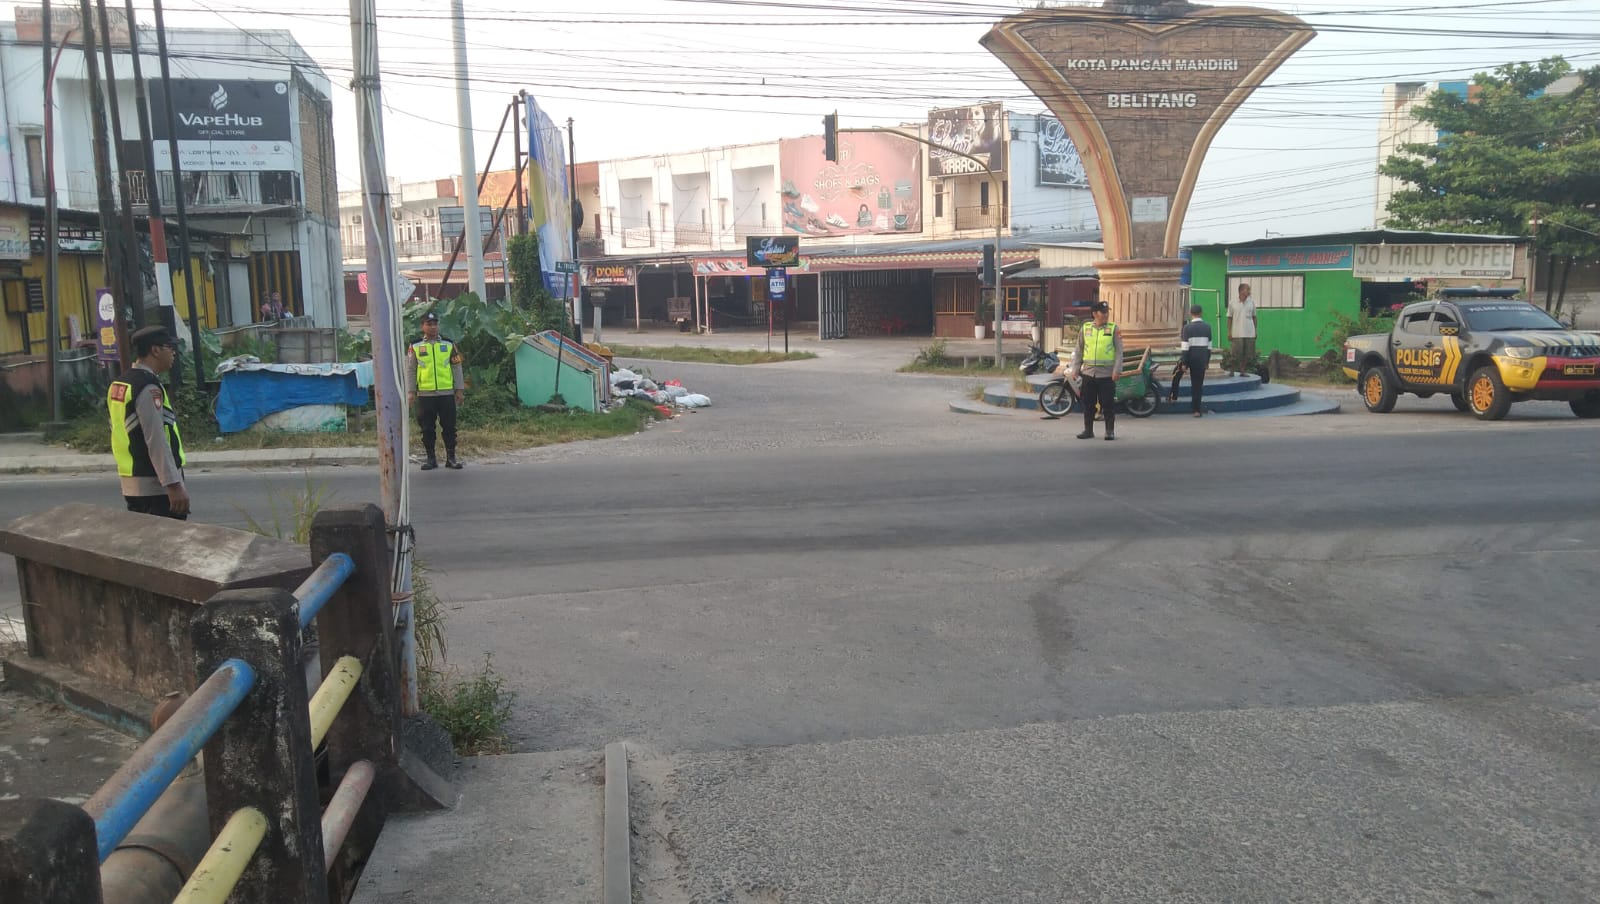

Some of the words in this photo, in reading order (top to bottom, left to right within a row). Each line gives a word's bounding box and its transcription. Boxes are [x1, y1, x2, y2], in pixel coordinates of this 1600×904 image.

[1067, 58, 1107, 71] KOTA
[1111, 58, 1172, 71] PANGAN
[941, 159, 987, 174] KARAOK
[855, 175, 880, 185] BAGS
[1358, 246, 1380, 265] JO
[1389, 246, 1435, 266] HALU
[1445, 246, 1512, 267] COFFEE
[1396, 349, 1434, 366] POLISI
